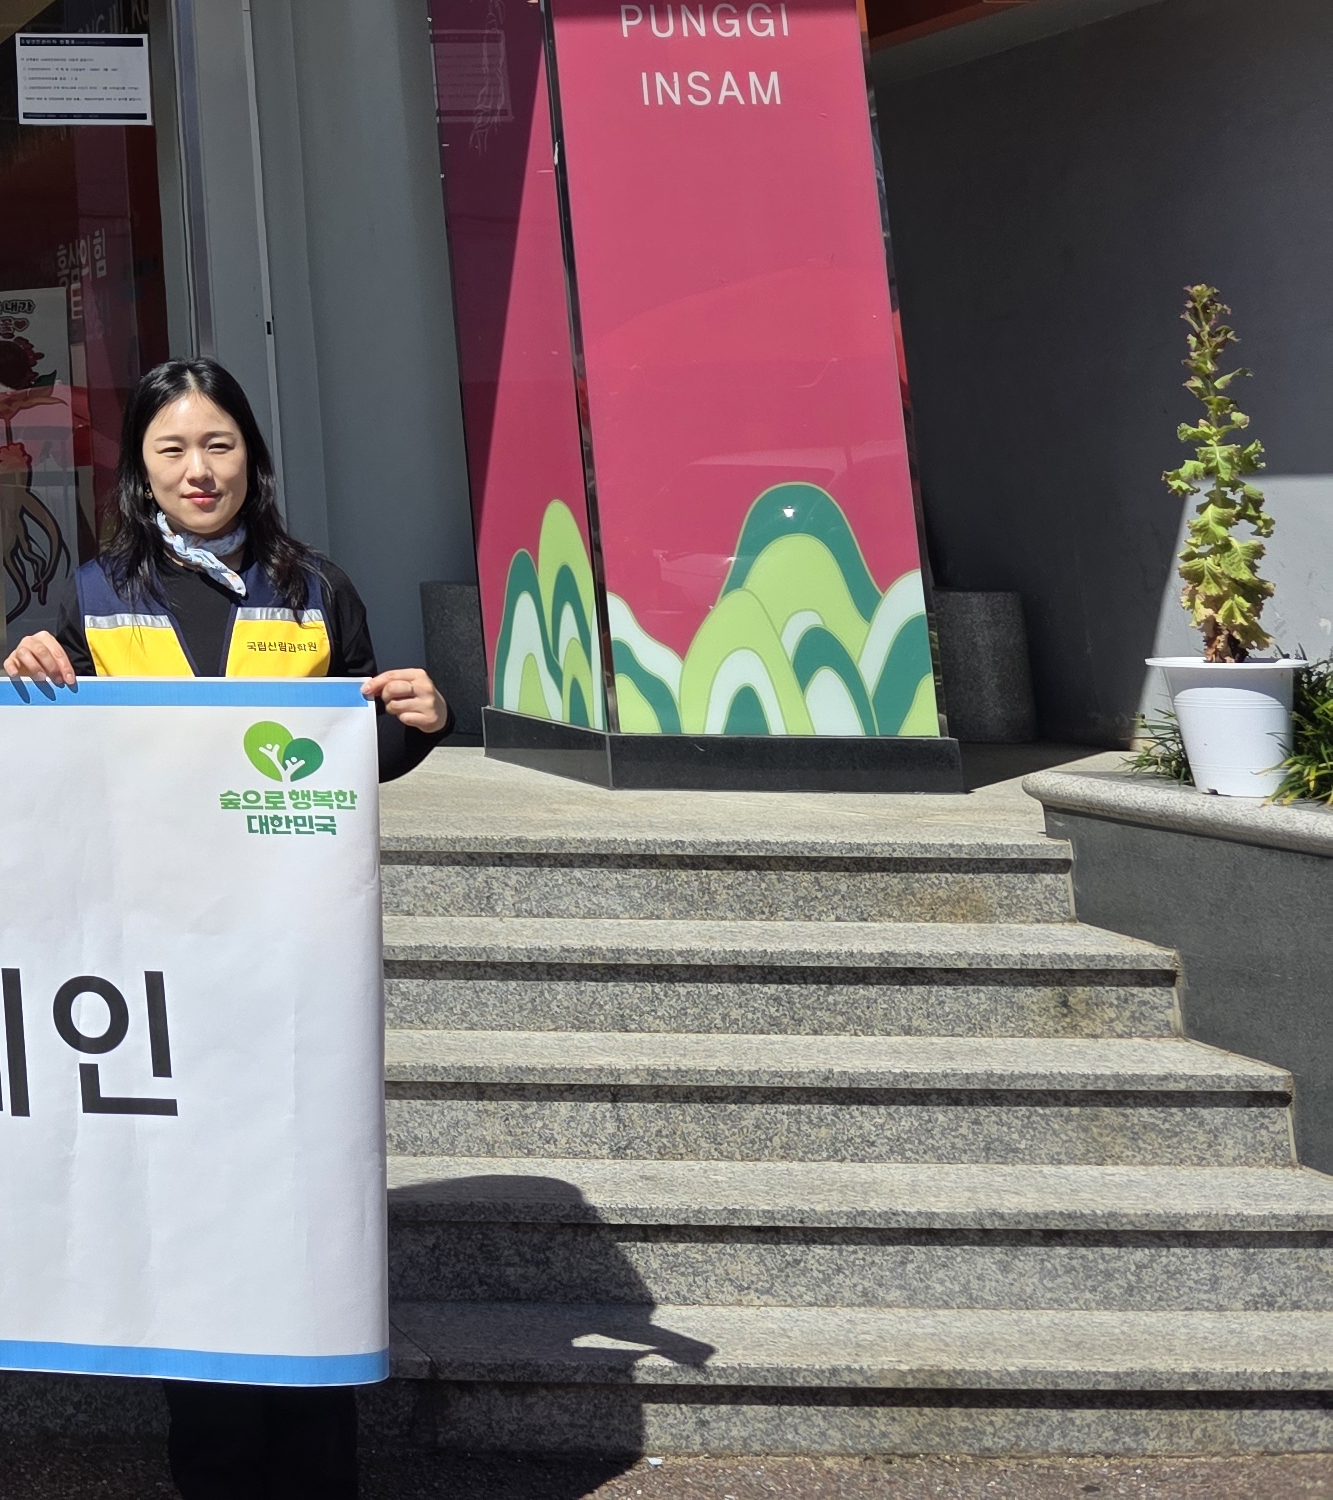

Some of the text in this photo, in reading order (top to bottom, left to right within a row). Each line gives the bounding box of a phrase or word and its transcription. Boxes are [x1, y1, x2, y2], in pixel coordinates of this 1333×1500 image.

[620, 3, 789, 38] PUNGGI
[641, 71, 782, 106] INSAM
[219, 789, 358, 810] 숲으로 행복한
[246, 814, 337, 835] 대한민국
